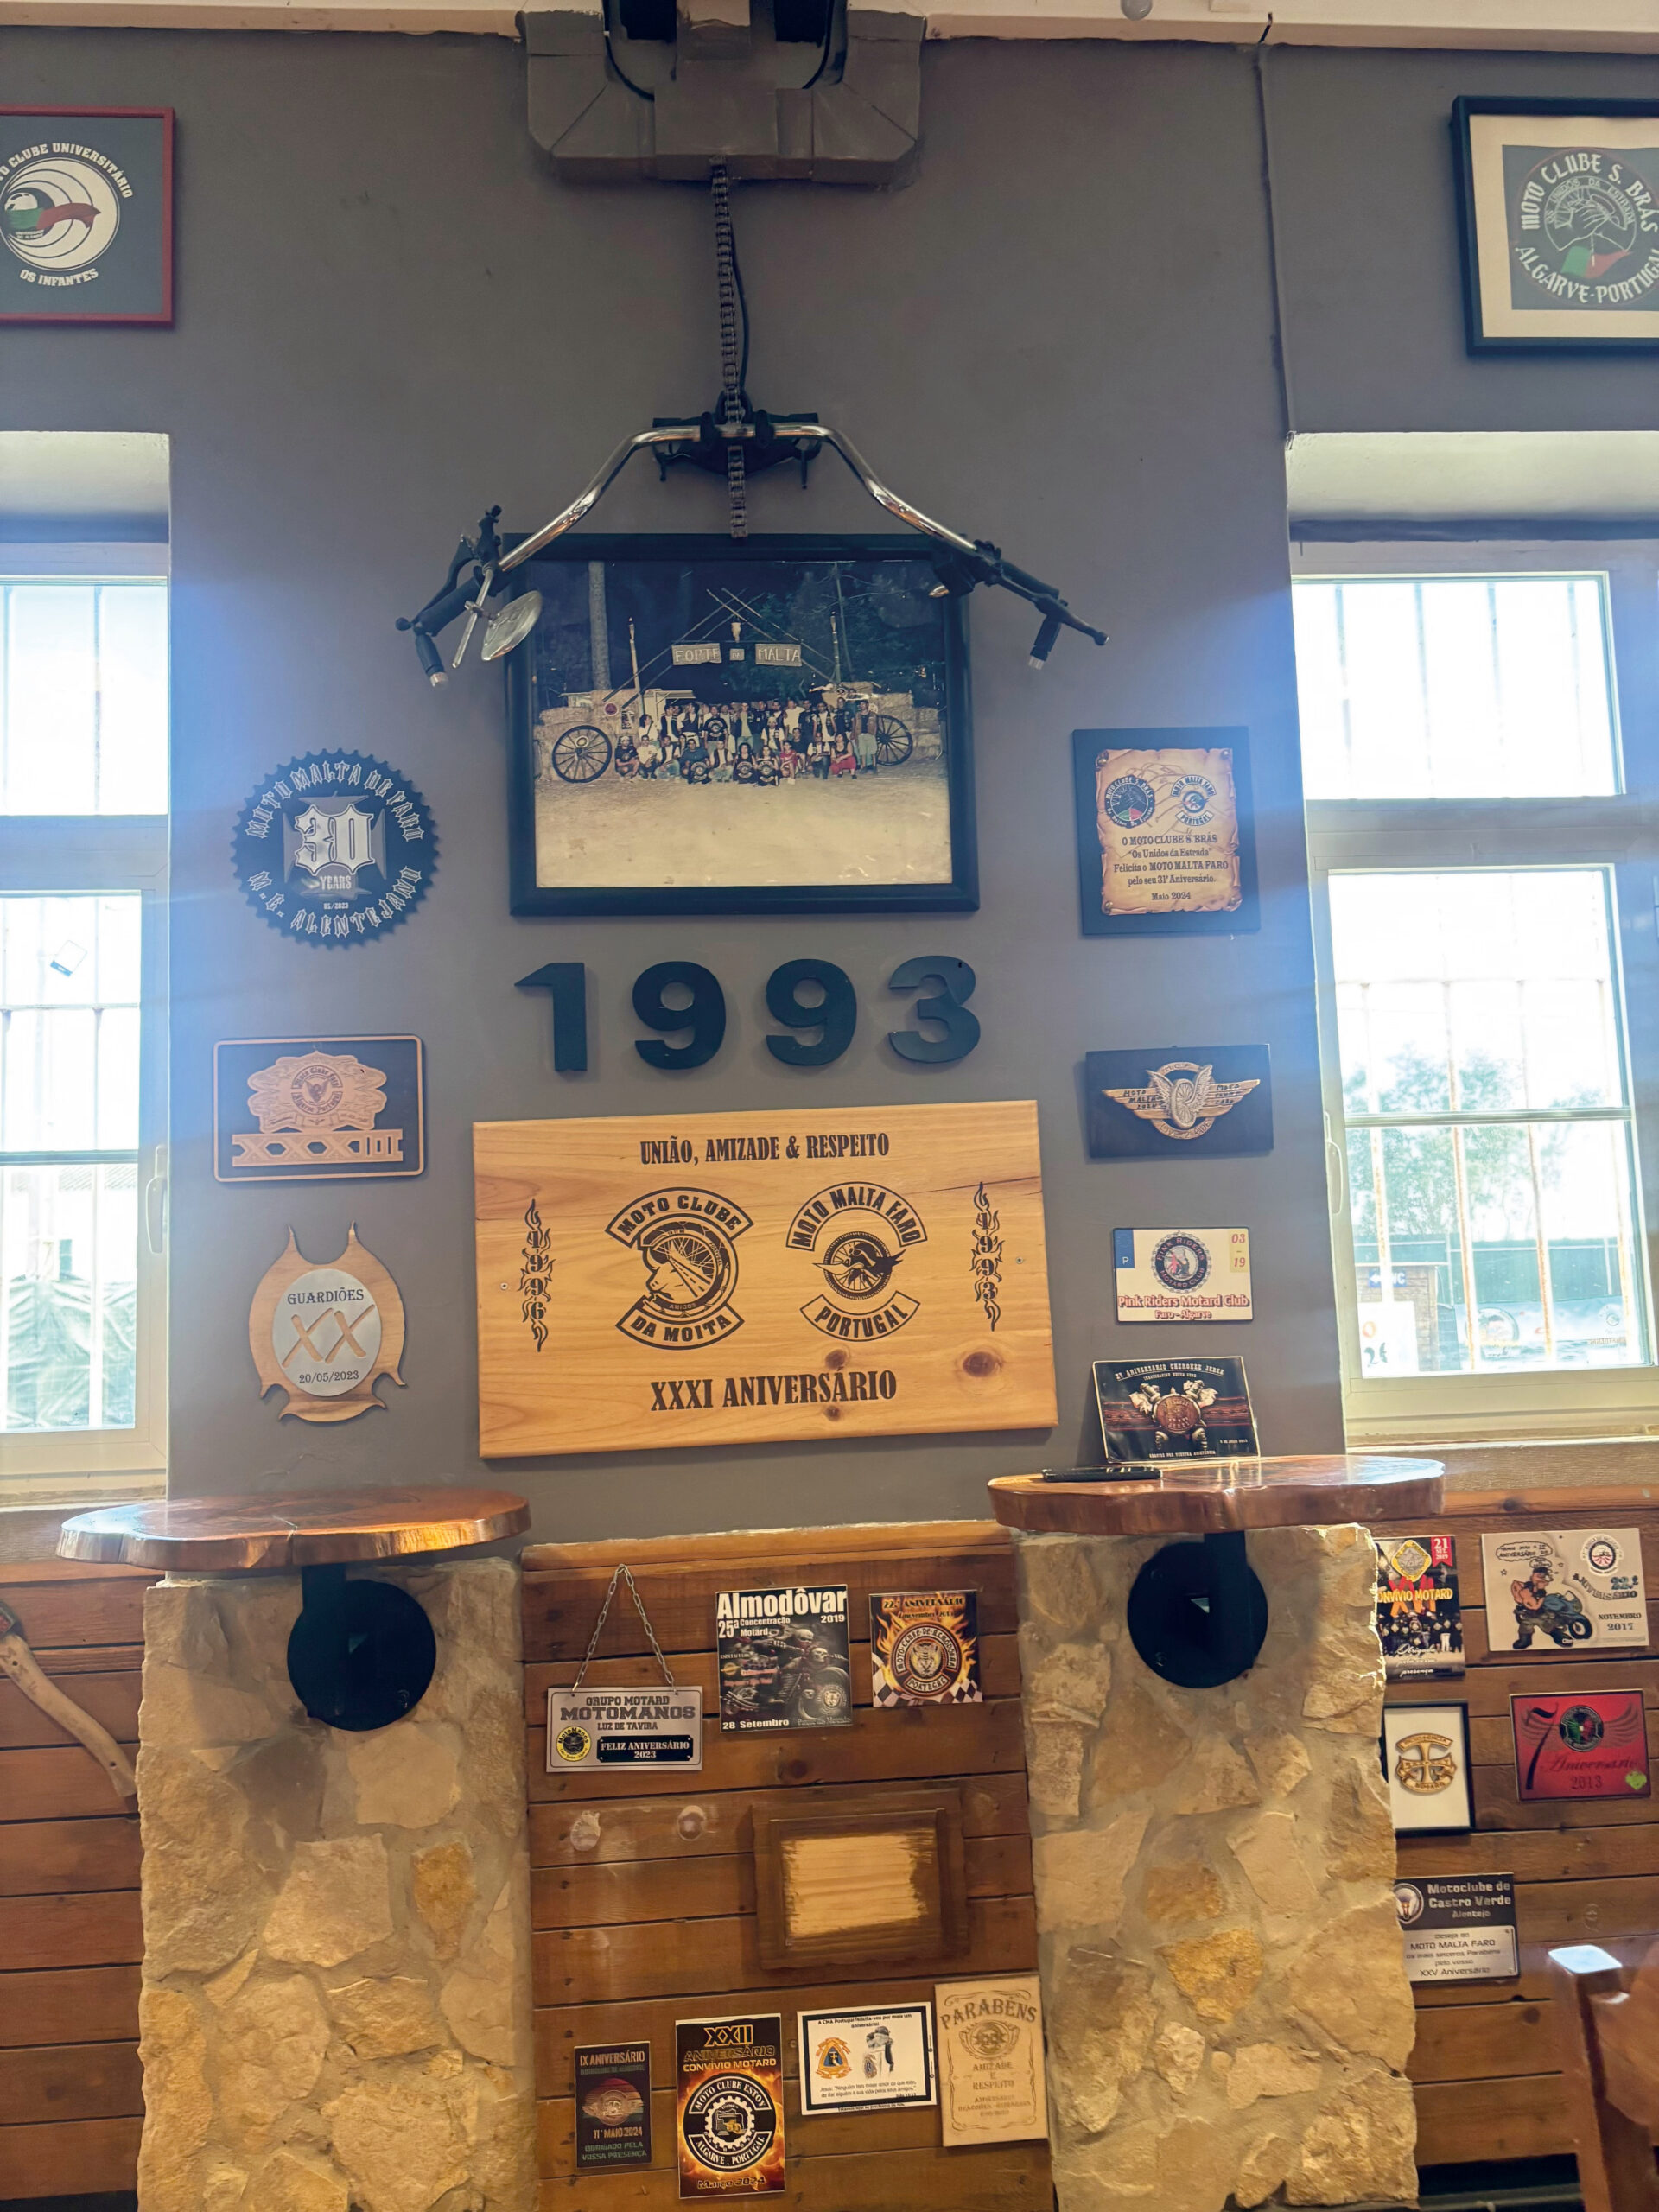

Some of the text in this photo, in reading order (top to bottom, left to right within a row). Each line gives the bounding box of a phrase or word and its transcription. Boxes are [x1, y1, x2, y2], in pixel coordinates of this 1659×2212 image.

[8, 143, 134, 198] CLUBE UNIVERSITÁRIO
[1521, 181, 1545, 230] MOTO
[1541, 153, 1601, 183] CLUBE
[1608, 164, 1623, 184] S.
[20, 269, 99, 286] OS INFANTES
[758, 649, 801, 662] MALTA
[245, 779, 293, 840] MOTO
[289, 760, 363, 792] MALTA
[385, 790, 426, 843] FARO
[295, 804, 377, 876] 30
[1122, 836, 1128, 845] O
[1194, 832, 1217, 843] BRÁS
[1142, 848, 1169, 858] Unidos
[1169, 848, 1179, 857] da
[1114, 863, 1141, 873] Felicita
[1149, 862, 1173, 871] MOTO
[1174, 861, 1204, 870] MALTA
[1205, 861, 1229, 869] FARO
[319, 875, 353, 891] YEARS
[1128, 876, 1143, 887] pelo
[290, 866, 423, 938] ALENTEJANO
[1152, 892, 1169, 900] Maio
[514, 956, 981, 1072] 1993
[640, 1133, 890, 1166] UNIÃO, AMIZADE & RESPEITO
[616, 1194, 743, 1237] MOTO CLUBE
[791, 1186, 921, 1247] MOTO MALTA FARO
[1231, 1233, 1245, 1244] 03
[1122, 1256, 1129, 1266] P
[1233, 1256, 1245, 1268] 19
[287, 1287, 365, 1306] GUARDIÕES
[1118, 1294, 1250, 1307] Pink Riders Motard Club
[814, 1303, 910, 1338] PORTUGAL
[1154, 1309, 1211, 1320] Faro Algarve
[629, 1313, 732, 1343] DA MOITA
[281, 1303, 376, 1369] XX
[298, 1370, 359, 1384] 20/05/2023
[650, 1367, 898, 1412] XXXI ANIVERSÁRIO
[1433, 1537, 1449, 1549] 21
[1414, 1587, 1454, 1601] MOTARD
[717, 1587, 848, 1620] Almodôvar
[740, 1616, 791, 1627] Concentração
[821, 1613, 846, 1624] 2019
[740, 1627, 769, 1637] Motard
[1607, 1623, 1634, 1631] 2017
[586, 1695, 671, 1707] GRUPO MOTARD
[560, 1705, 696, 1721] MOTOMANOS
[597, 1722, 612, 1731] LUZ
[626, 1721, 658, 1730] TAVIRA
[722, 1719, 735, 1730] 28
[739, 1718, 790, 1729] Setembro
[601, 1739, 690, 1751] FELIZ ANIVERSÁRIO
[633, 1751, 658, 1759] 2023
[1427, 1881, 1510, 1895] Motoclube de
[1428, 1895, 1511, 1909] Castro Verde
[1452, 1909, 1491, 1918] Alentejo
[1438, 1940, 1469, 1948] MALTA
[939, 1995, 1038, 2031] PARABÉNS
[704, 2024, 753, 2048] XXII
[580, 2049, 645, 2066] IX ANIVERSÁRIO
[683, 2044, 776, 2063] ANIVERSÁRIO
[683, 2057, 777, 2072] CONVÍVIO MOTARD
[973, 2061, 1013, 2072] AMIZADE
[695, 2079, 766, 2111] MOTO CLUBE ESTOY
[604, 2126, 643, 2139] MAIO 2024
[696, 2136, 766, 2165] ALGARVE PORTUGAL
[734, 2175, 766, 2186] 2024
